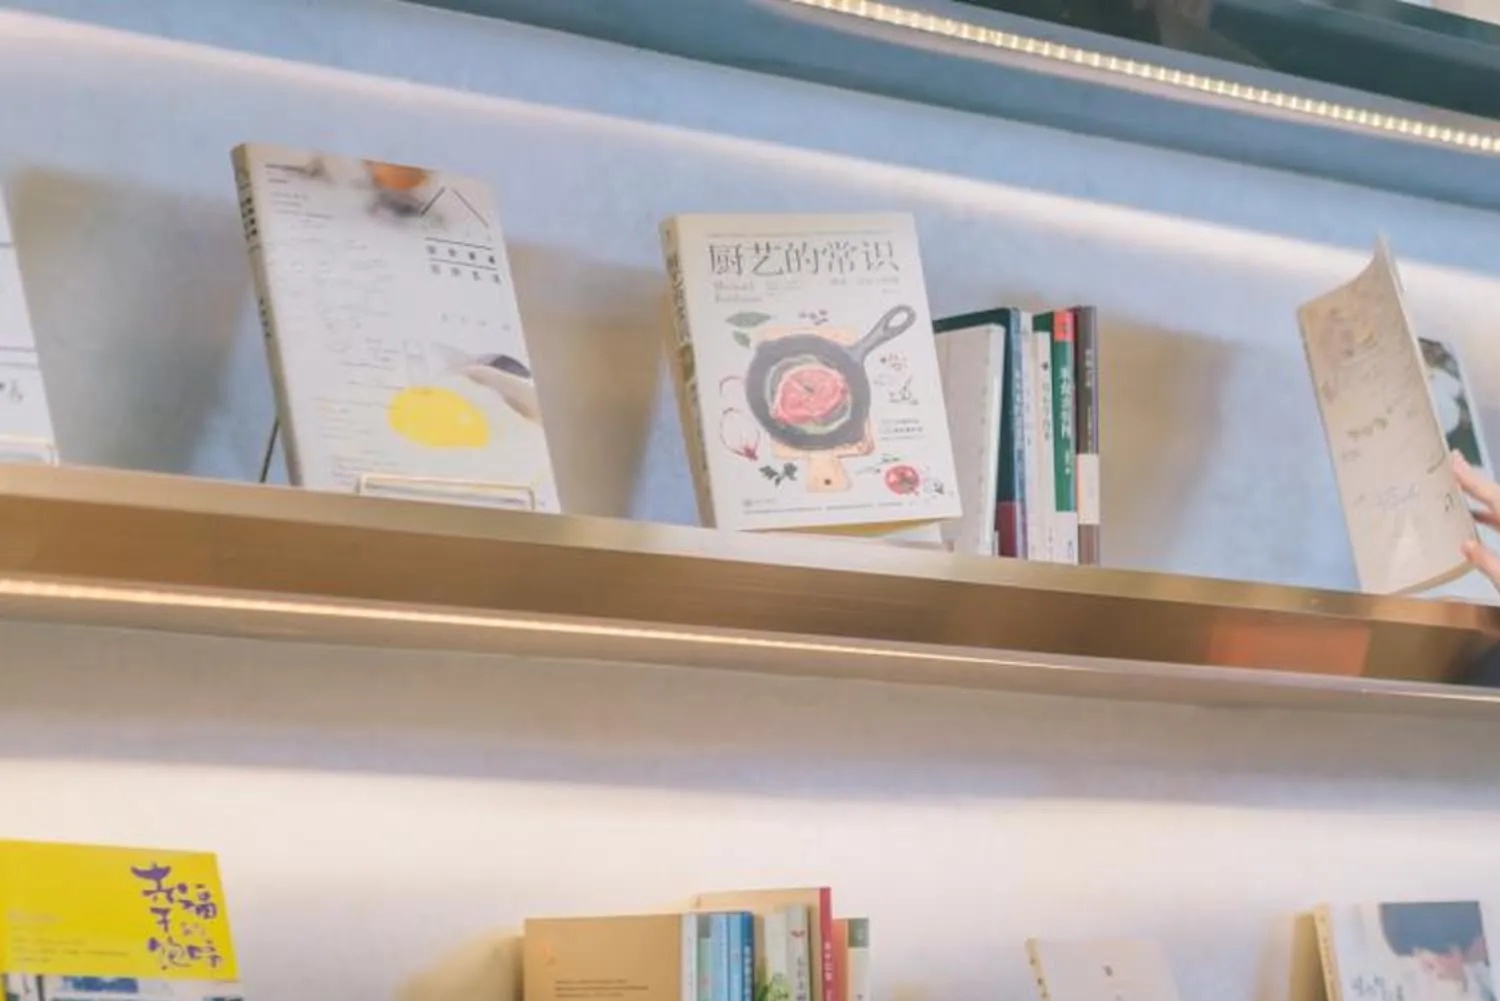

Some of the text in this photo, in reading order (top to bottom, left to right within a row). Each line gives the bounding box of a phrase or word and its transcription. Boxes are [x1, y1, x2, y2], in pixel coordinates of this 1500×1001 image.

[708, 240, 900, 278] 厨艺的常识
